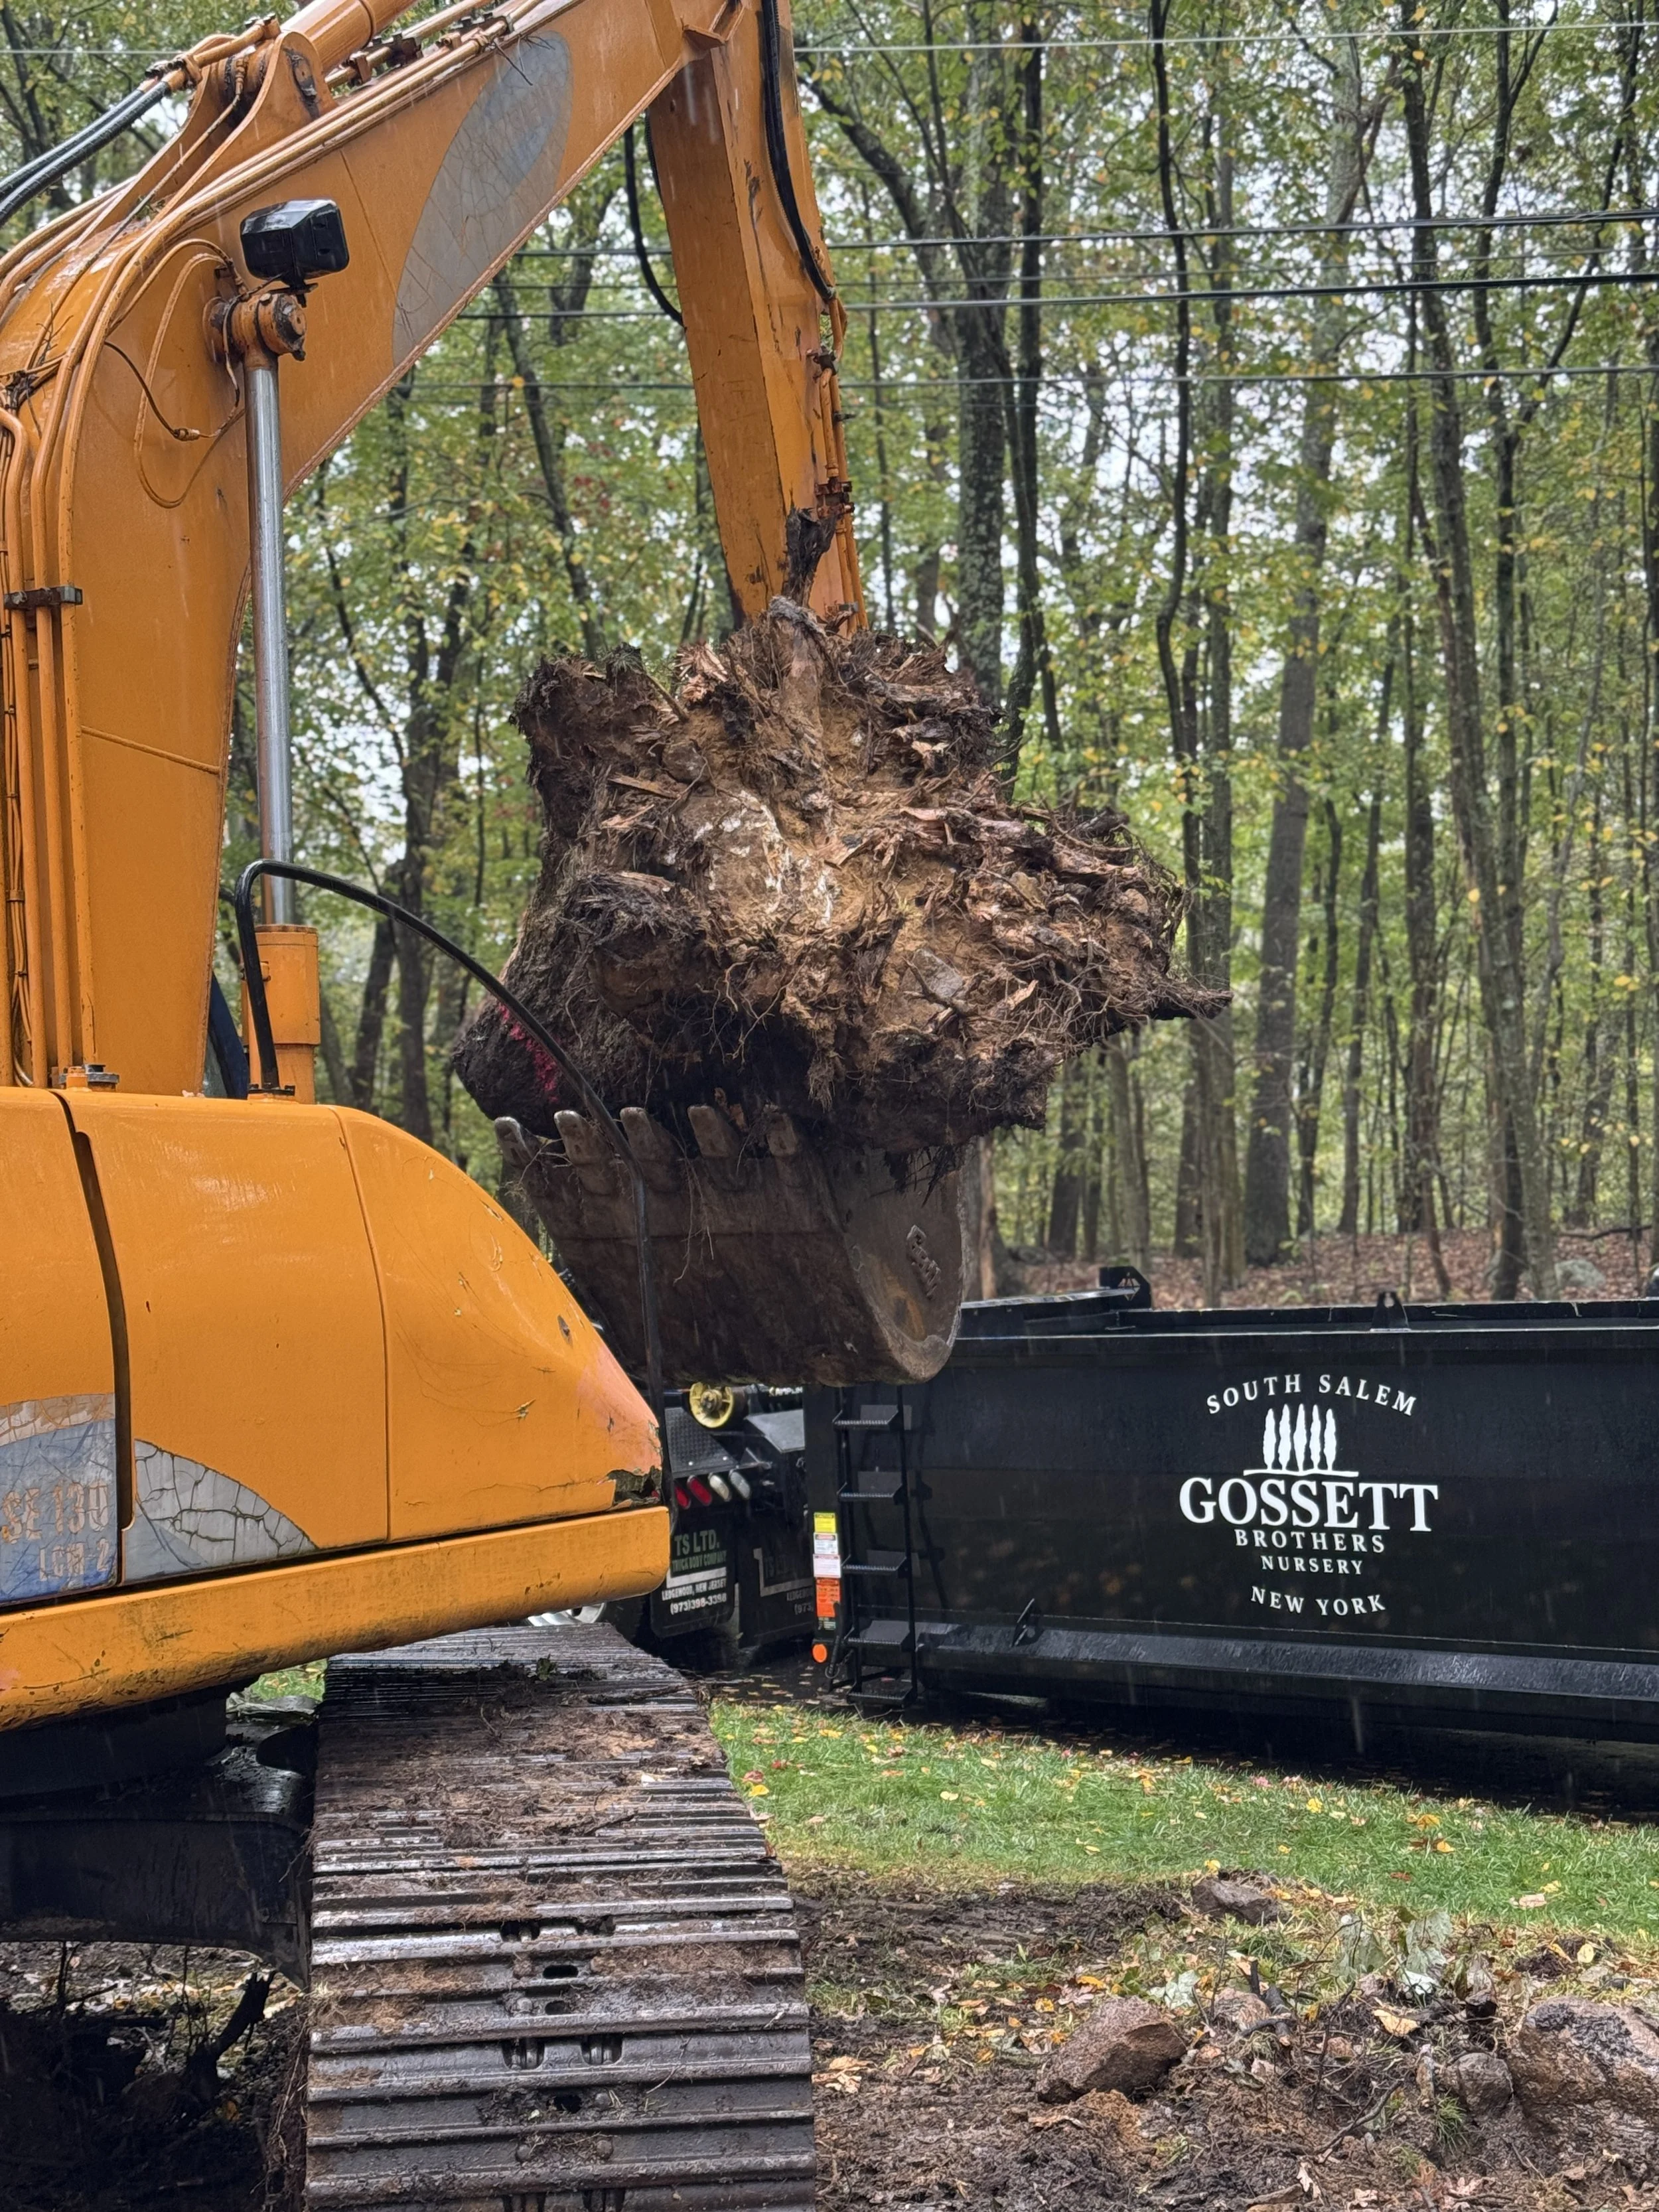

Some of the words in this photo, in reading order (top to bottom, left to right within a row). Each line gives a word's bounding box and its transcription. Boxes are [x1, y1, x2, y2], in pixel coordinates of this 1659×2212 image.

[1206, 1374, 1301, 1414] SOUTH
[1319, 1374, 1417, 1416] SALEM
[54, 1479, 109, 1535] 130
[1179, 1477, 1439, 1532] GOSSETT
[674, 1534, 690, 1556] TS
[693, 1529, 720, 1553] LTD.
[1234, 1528, 1385, 1553] BROTHERS
[1260, 1555, 1362, 1575] NURSERY
[695, 1582, 707, 1593] NEW
[708, 1578, 727, 1591] JERSEY
[1250, 1585, 1305, 1613] NEW
[1315, 1594, 1386, 1616] YORK
